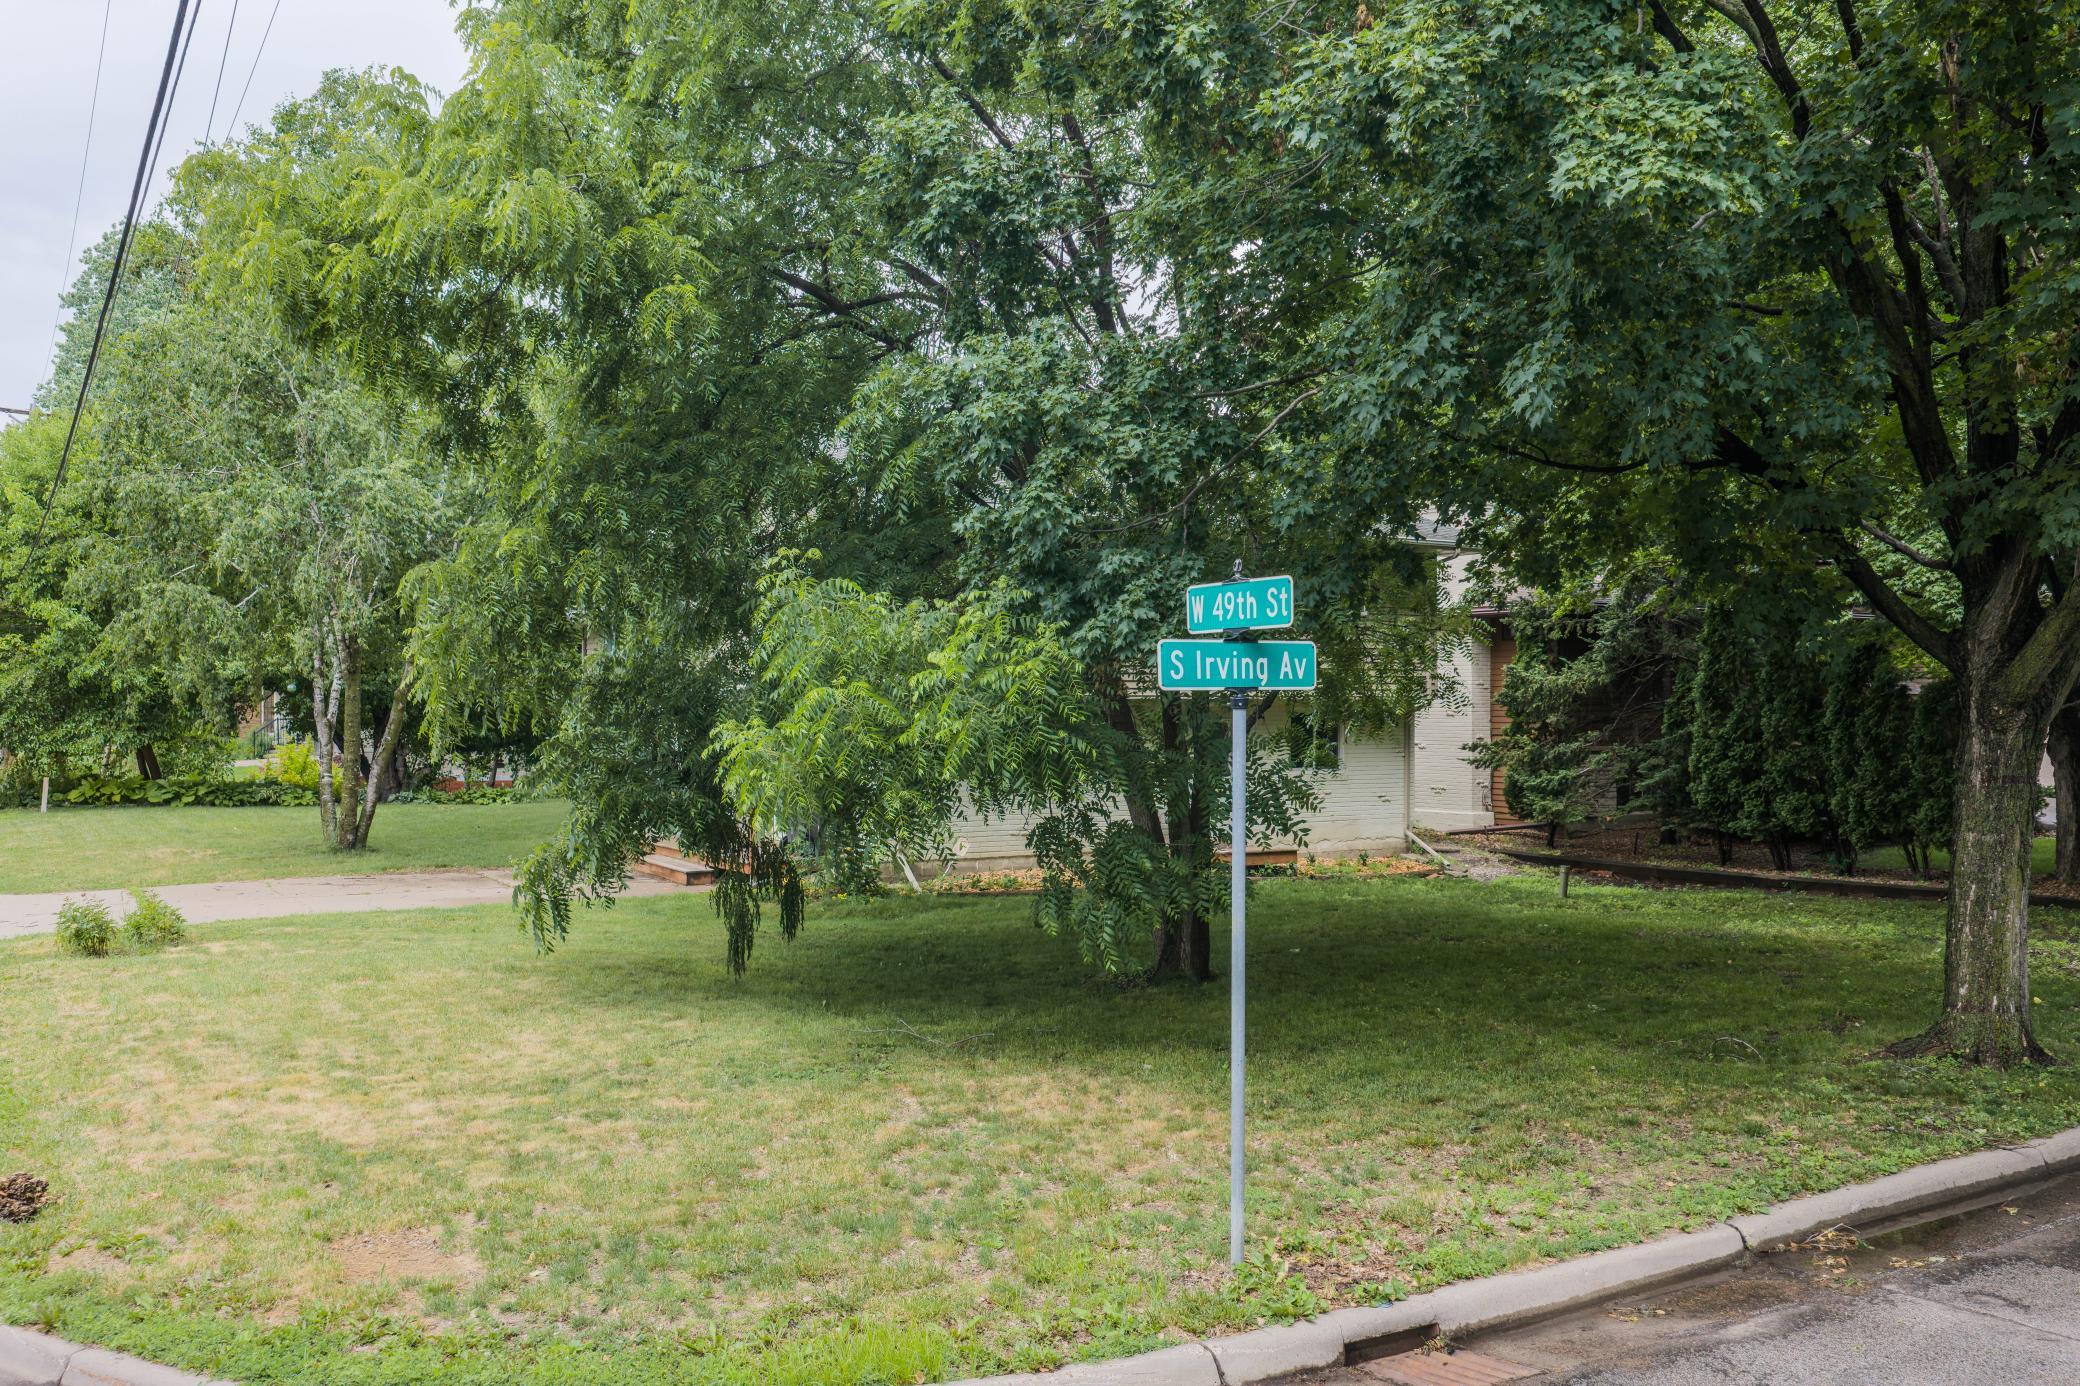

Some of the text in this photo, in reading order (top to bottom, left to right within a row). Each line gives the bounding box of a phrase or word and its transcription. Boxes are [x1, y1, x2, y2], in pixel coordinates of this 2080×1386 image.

[1191, 587, 1288, 624] W 49th St
[1170, 650, 1307, 686] S Irving Av
